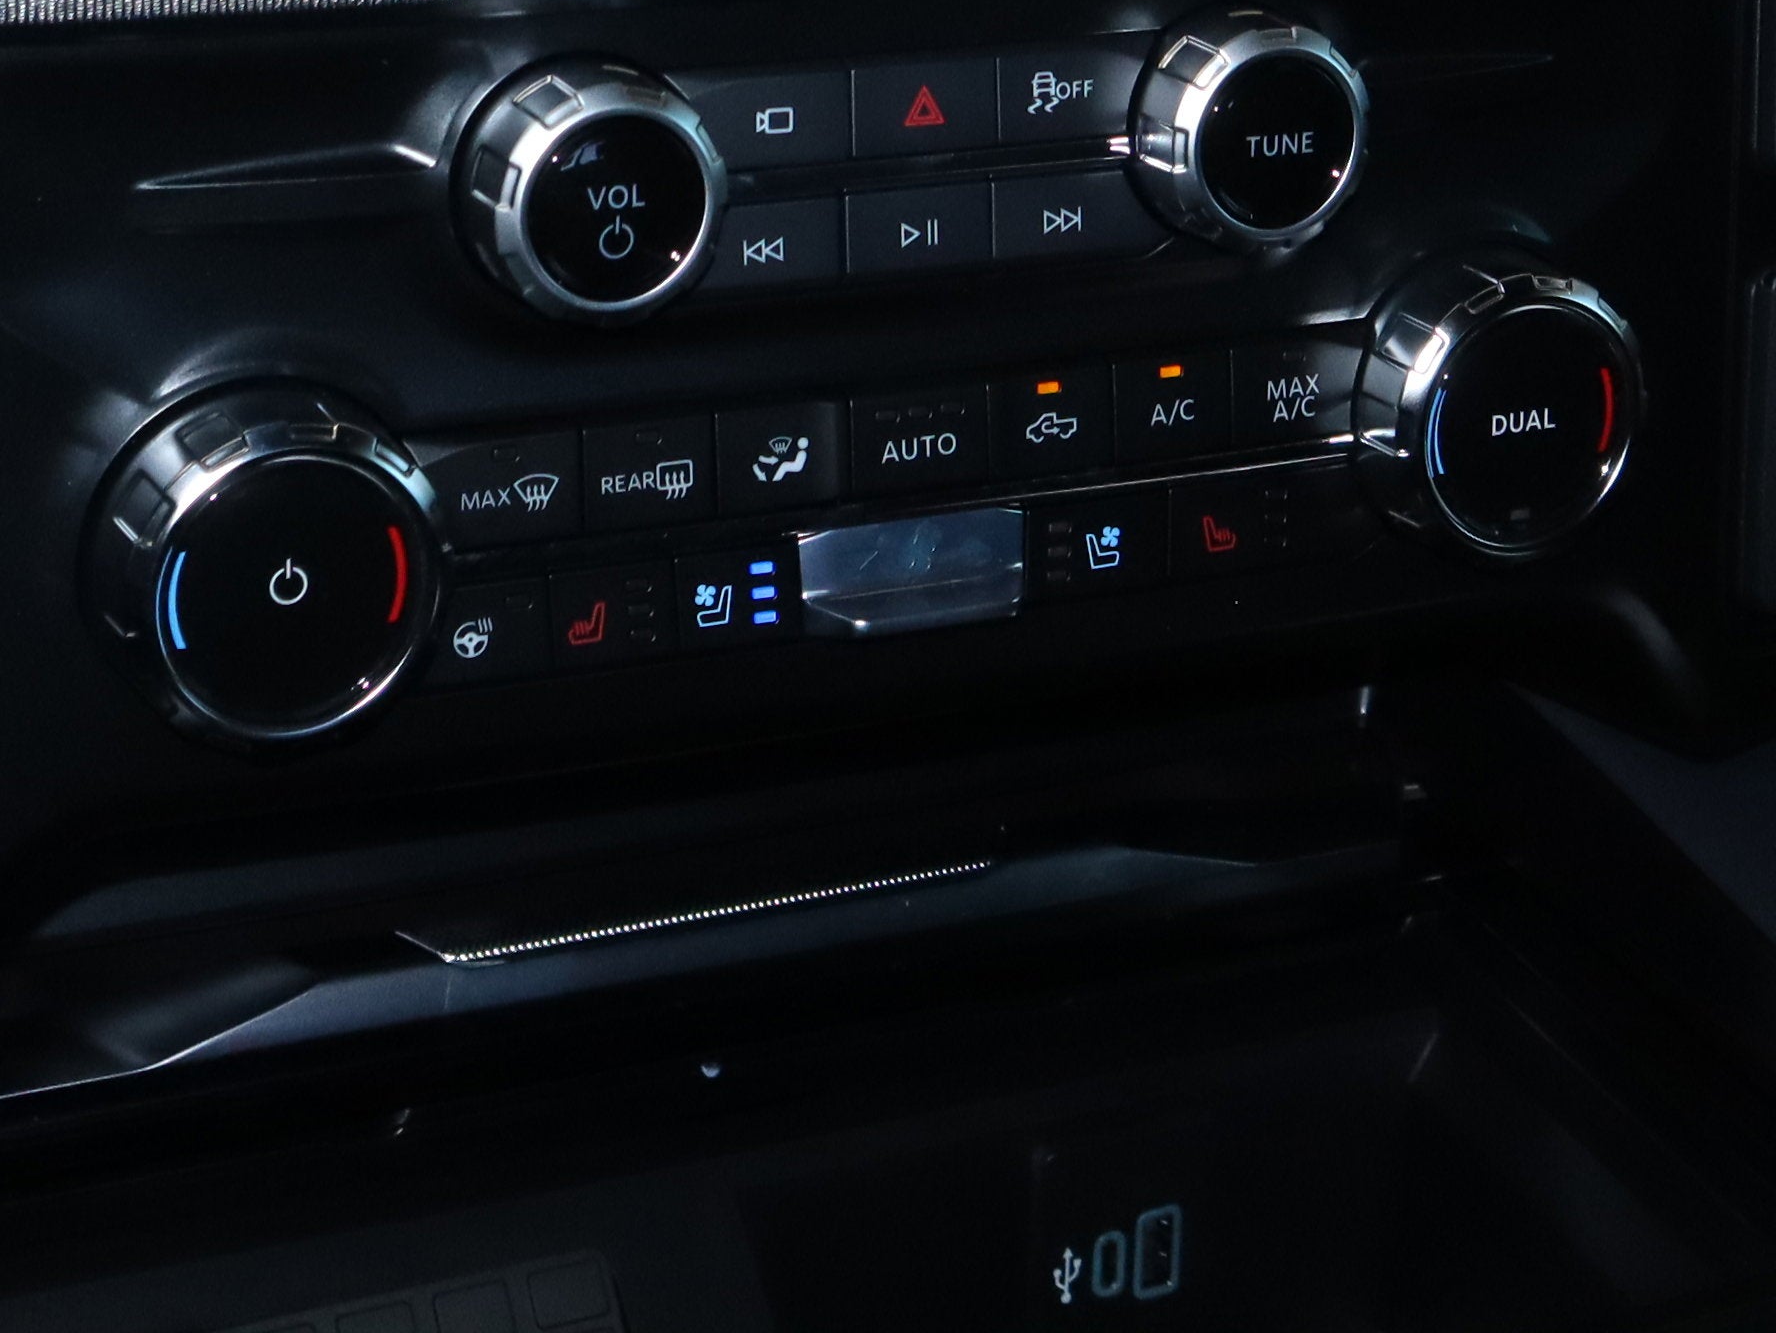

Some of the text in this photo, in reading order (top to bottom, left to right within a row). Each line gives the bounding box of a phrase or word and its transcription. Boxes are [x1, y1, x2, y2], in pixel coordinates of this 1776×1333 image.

[1055, 78, 1094, 100] OFF
[1246, 132, 1315, 158] TUNE
[587, 185, 645, 212] VOL
[1267, 374, 1320, 401] MAX
[1151, 400, 1195, 427] A/C
[1273, 394, 1316, 422] A/C
[1491, 408, 1556, 437] DUAL
[882, 433, 957, 464] AUTO
[601, 471, 655, 496] REAR
[460, 486, 511, 512] MAX
